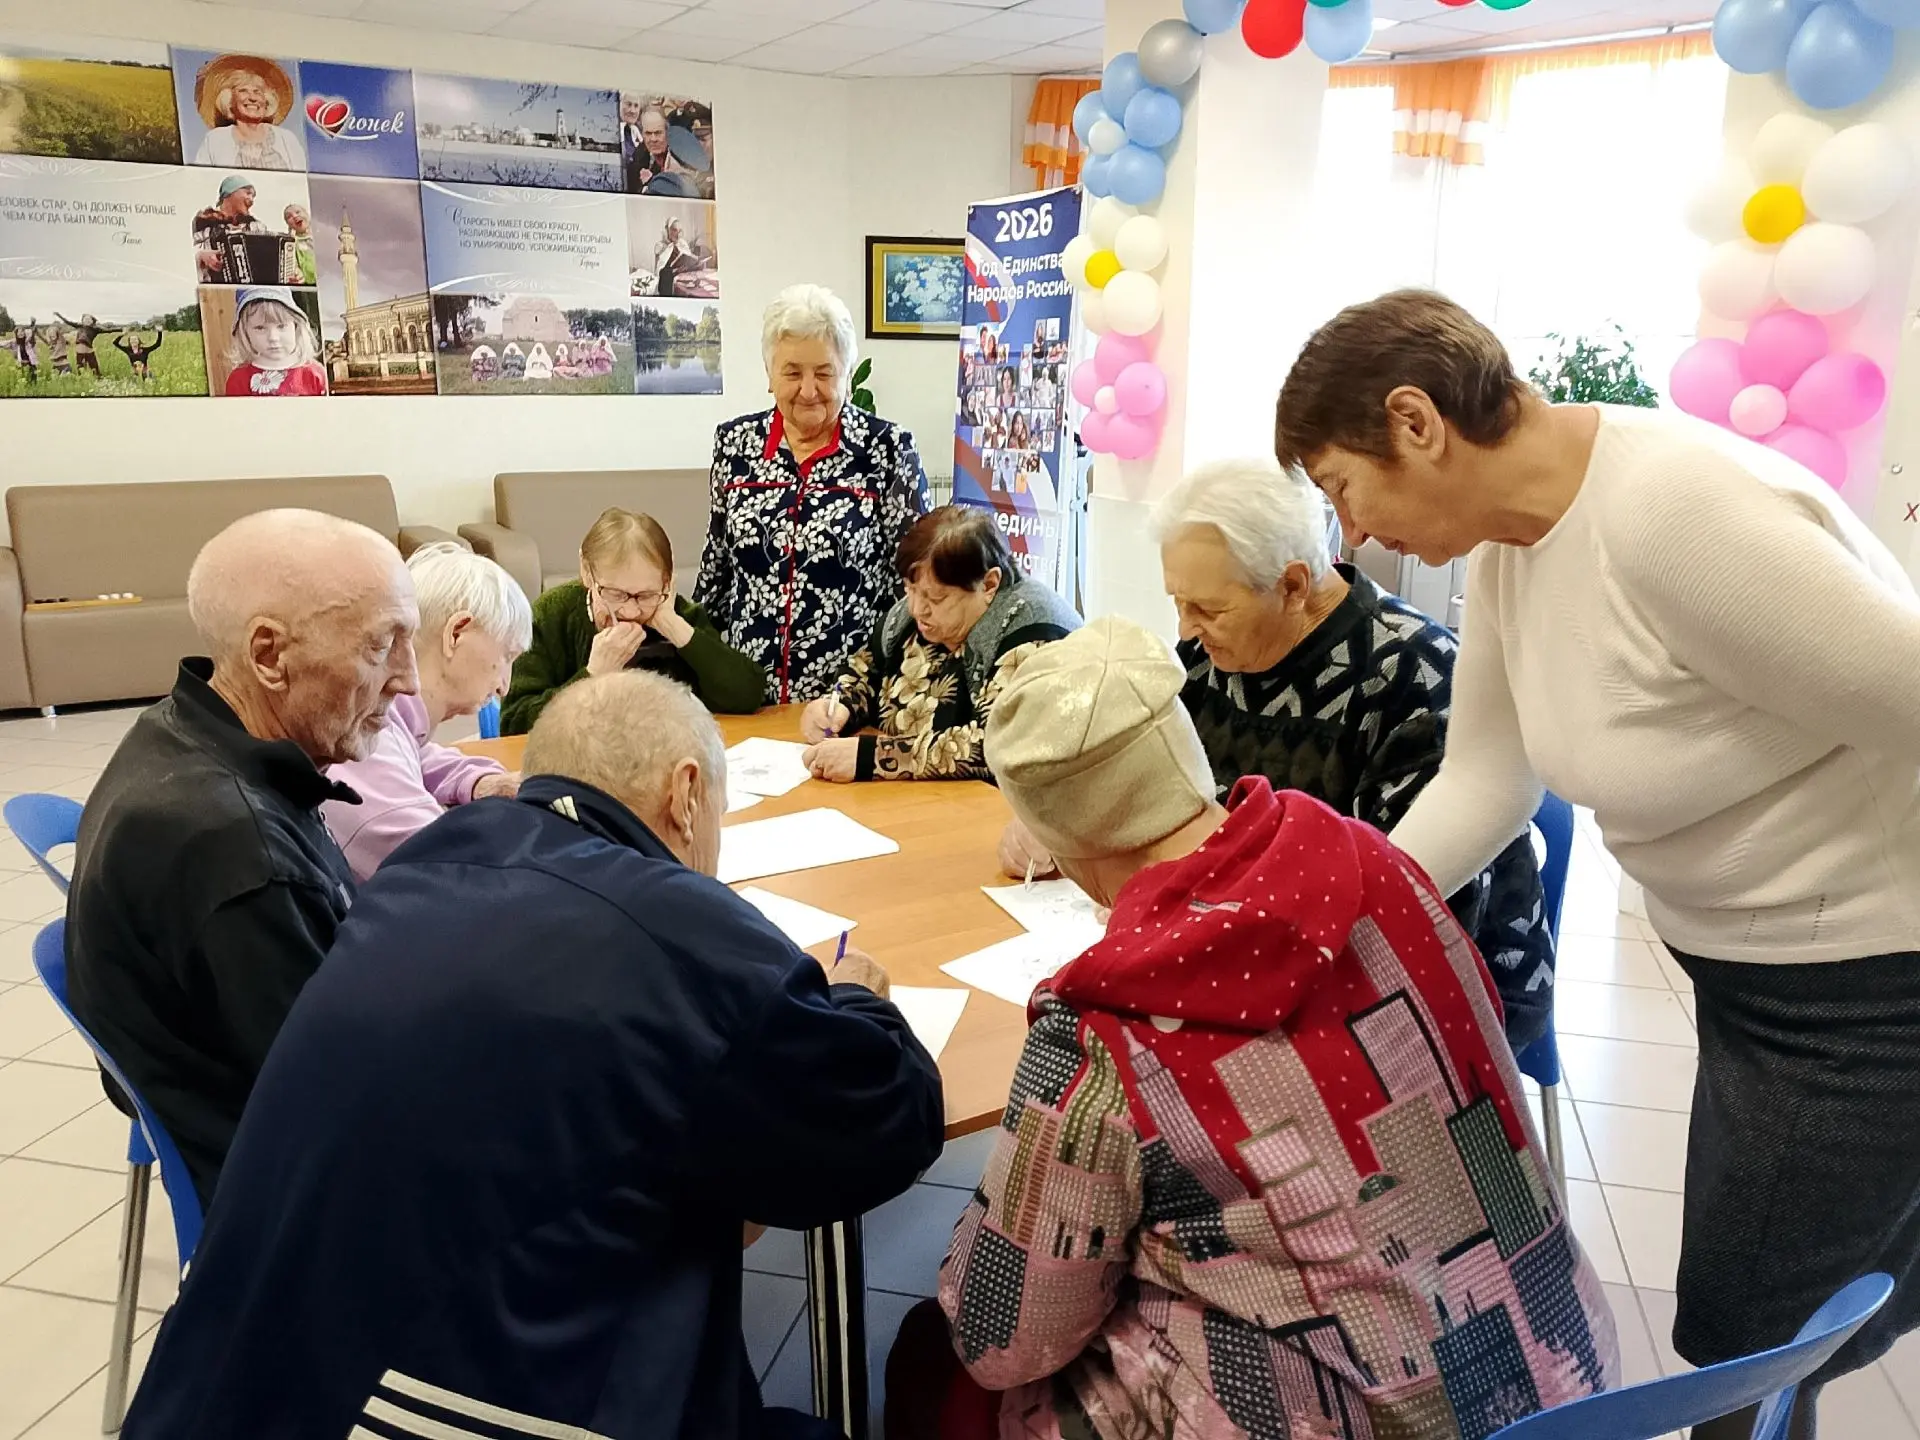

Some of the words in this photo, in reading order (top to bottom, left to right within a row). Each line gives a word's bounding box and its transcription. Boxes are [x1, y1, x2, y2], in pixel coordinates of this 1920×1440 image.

[73, 201, 87, 211] ОН
[90, 202, 132, 213] ДОЛЖЕН
[135, 204, 176, 215] БОЛЬШЕ
[3, 210, 26, 221] ЧЕМ
[28, 211, 61, 223] КОГДА
[64, 212, 85, 224] БЫЛ
[88, 214, 126, 227] МОЛОД
[497, 218, 521, 228] ИМЕЕТ
[523, 220, 547, 230] СВОЮ
[994, 202, 1054, 243] 2026
[460, 240, 471, 248] НО
[521, 231, 531, 240] НЕ
[569, 233, 579, 243] НЕ
[975, 257, 1000, 278] Год
[967, 284, 1024, 306] Народов
[1026, 279, 1073, 299] России
